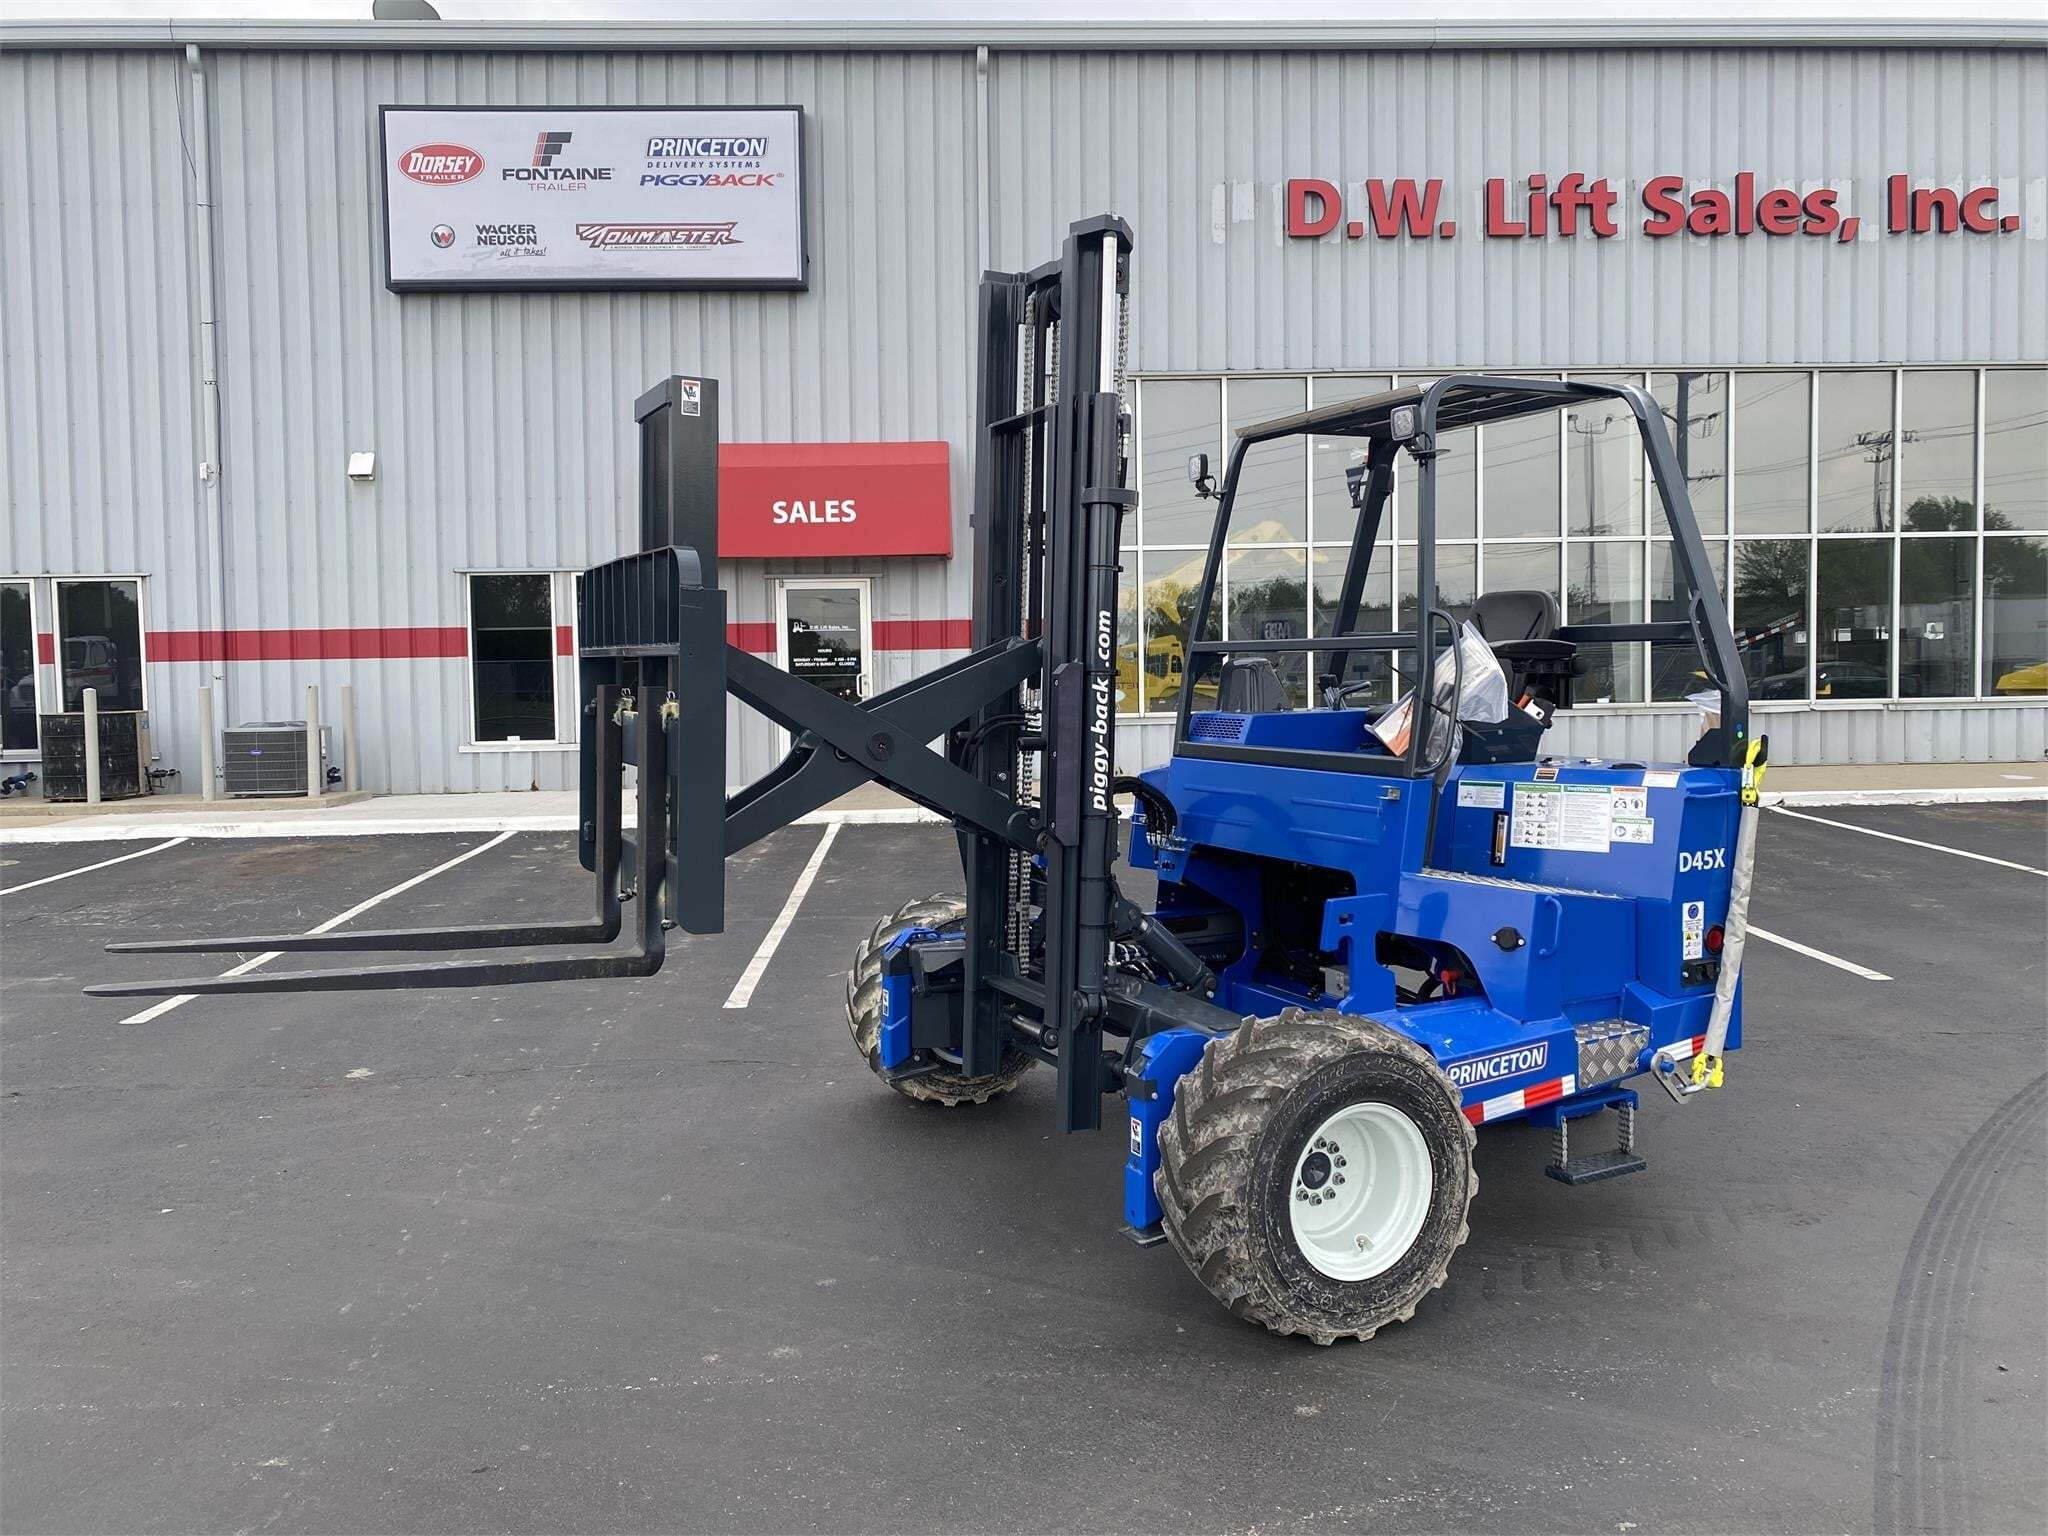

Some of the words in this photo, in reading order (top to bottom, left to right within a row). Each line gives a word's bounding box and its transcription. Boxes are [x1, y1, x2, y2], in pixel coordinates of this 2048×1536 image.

[648, 138, 767, 156] PRINCETON
[408, 152, 477, 173] DORSEY
[647, 161, 704, 169] DELIVERY
[502, 167, 612, 181] FONTAINE
[528, 183, 587, 191] TRAILER
[1287, 178, 1456, 238] D.W.
[1485, 173, 1618, 237] Lift
[1642, 171, 1861, 243] Sales,
[1888, 173, 2020, 234] Inc.
[475, 224, 536, 235] WACKER
[576, 222, 744, 248] TOWMASTER
[477, 235, 538, 246] NEUSON
[500, 248, 510, 257] all
[772, 499, 857, 524] SALES
[1098, 610, 1111, 668] .com
[1089, 676, 1110, 811] piggy-back
[1679, 848, 1726, 873] D45X
[1449, 1046, 1544, 1085] PRINCETON
